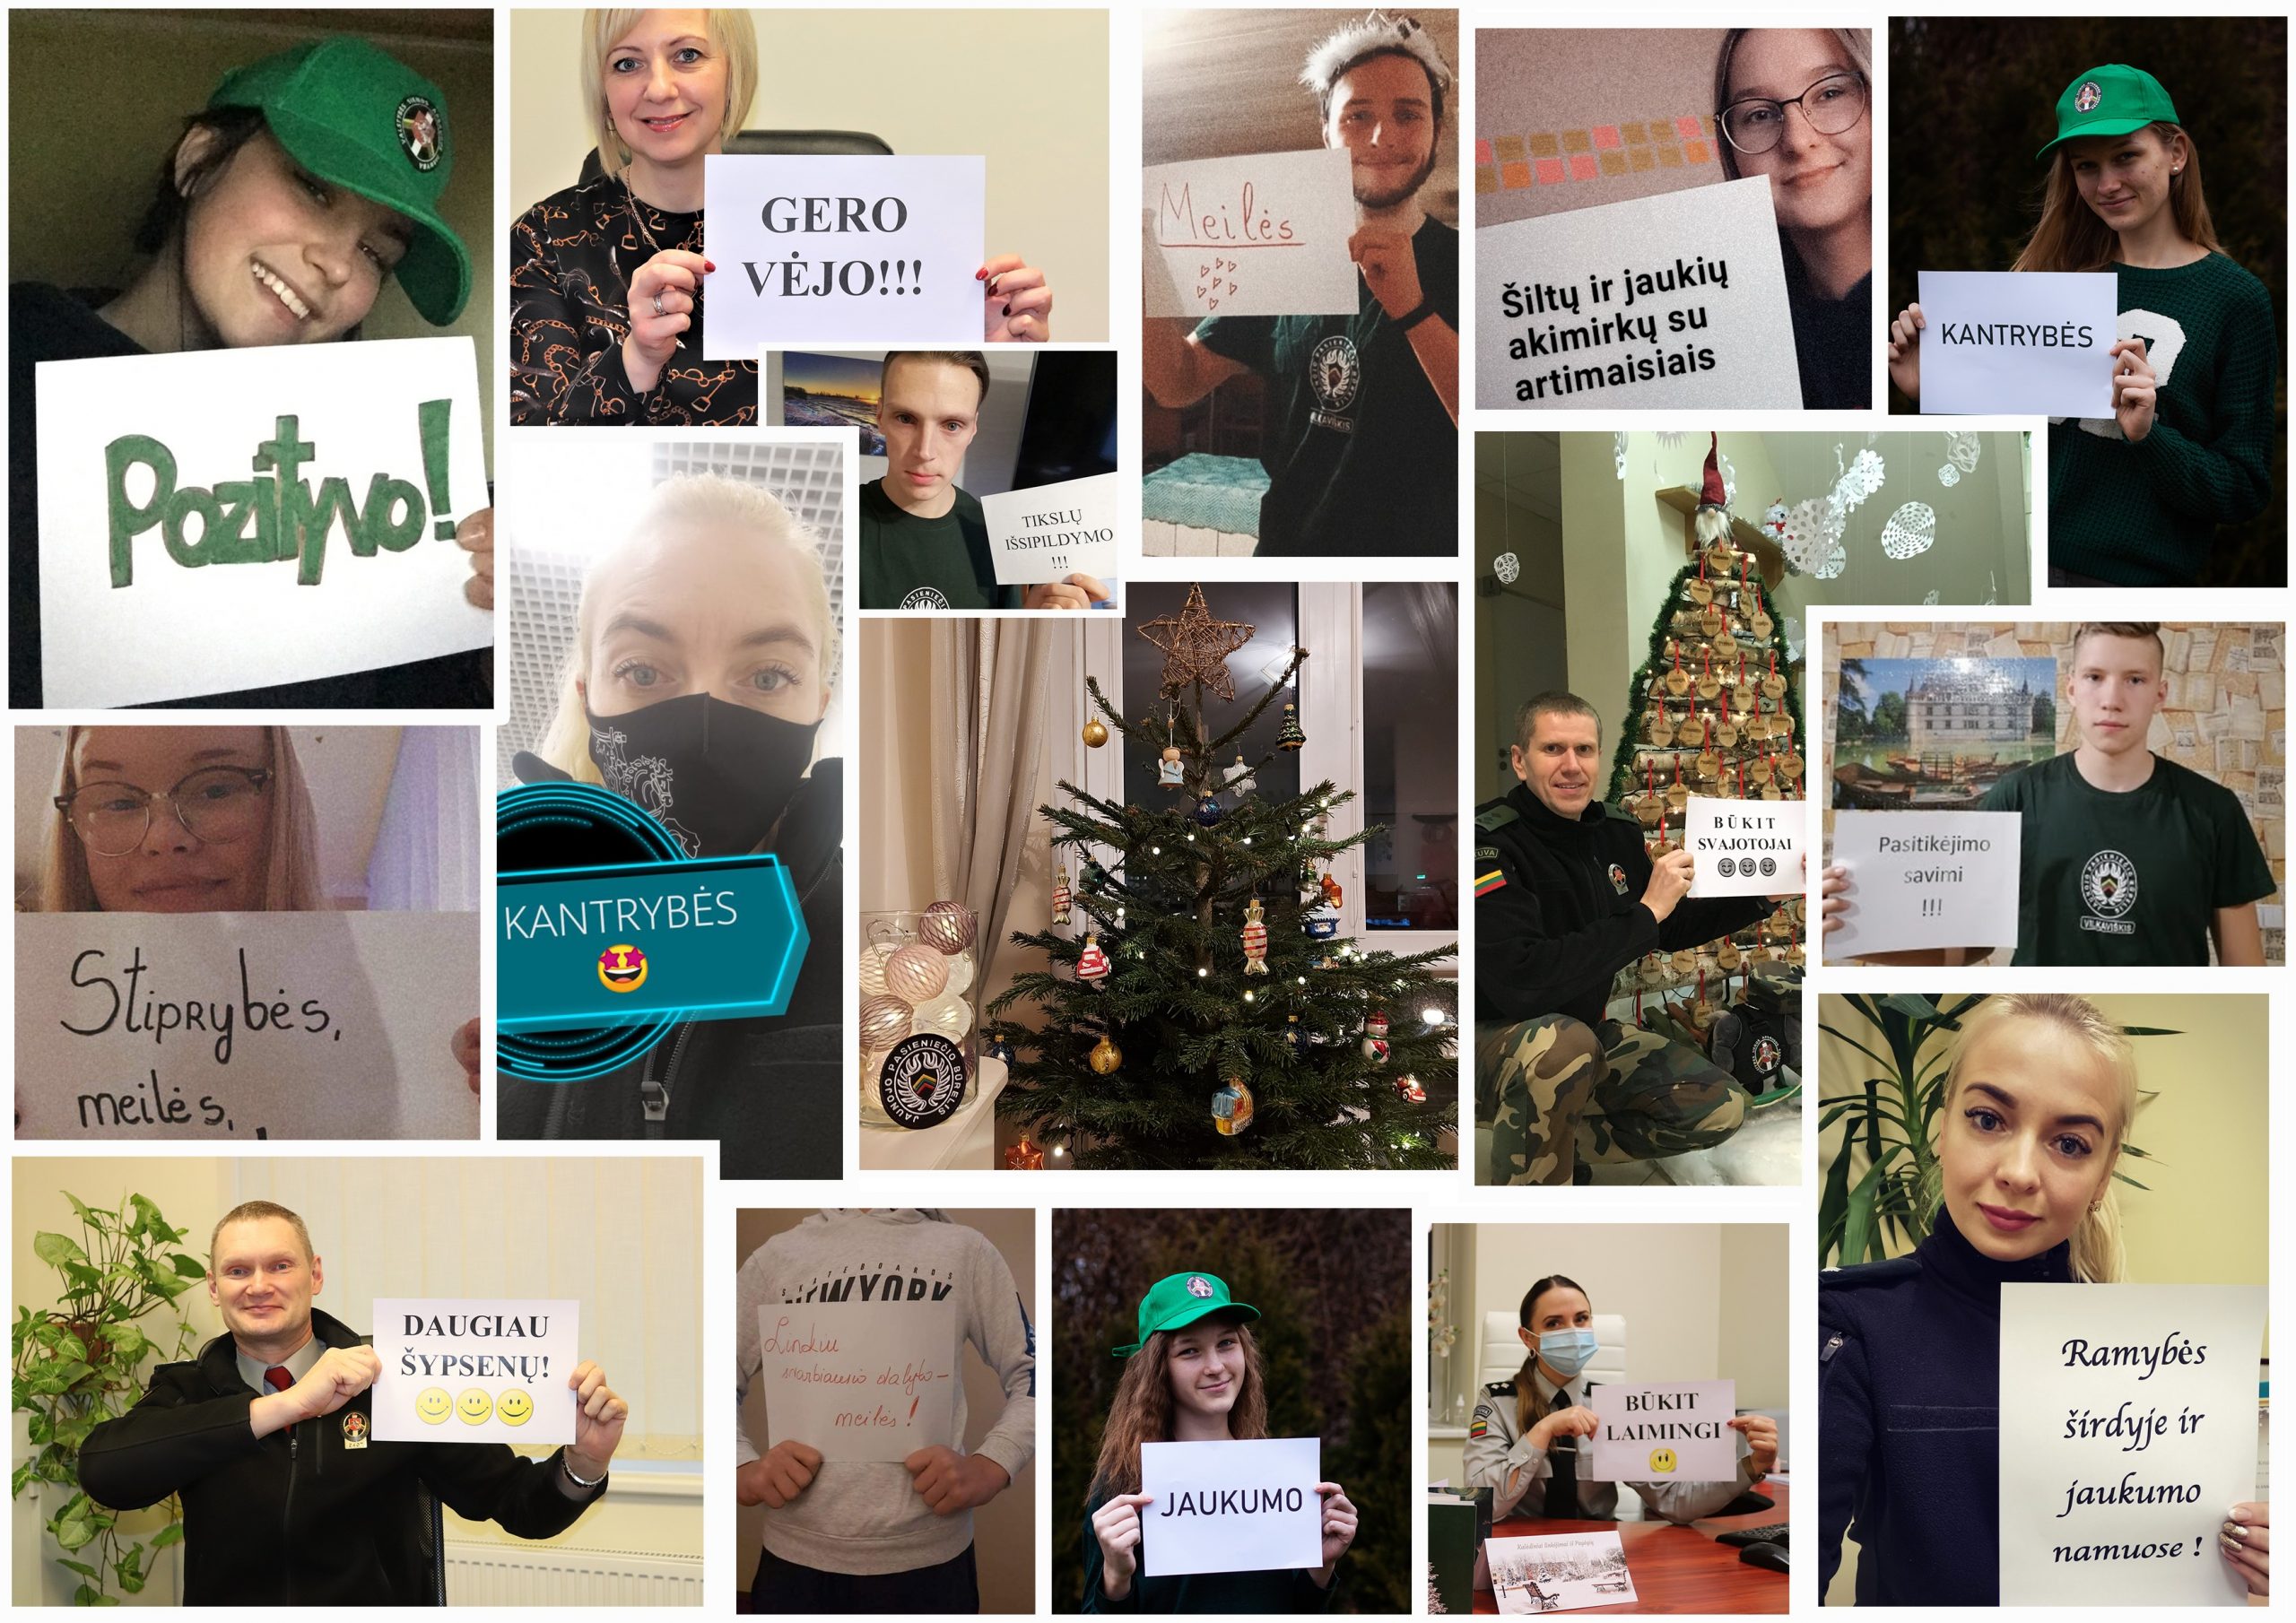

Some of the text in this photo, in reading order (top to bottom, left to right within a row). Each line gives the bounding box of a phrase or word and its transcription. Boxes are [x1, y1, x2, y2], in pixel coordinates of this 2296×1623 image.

[761, 196, 908, 234] GERO
[1161, 182, 1293, 240] Meilės
[741, 250, 922, 298] VĖJO!!!
[1501, 256, 1729, 318] Šiltų ir jaukių
[1509, 307, 1708, 360] akimirkų su
[1942, 321, 2093, 348] KANTRYBĖS
[1515, 343, 1716, 402] artimaisiais
[104, 399, 457, 589] Pozityvo!
[1022, 509, 1083, 528] TIKSLŲ
[1005, 528, 1113, 551] IŠSIPILDYMO
[1051, 556, 1068, 569] !!!
[902, 590, 948, 610] PASIENIEČI
[1698, 838, 1792, 851] SVAJOTOJAI
[1879, 835, 1992, 855] Pasitikėjimo
[1904, 865, 1963, 884] savimi
[1922, 898, 1943, 917] !!!
[888, 1040, 956, 1072] PASIENIEČIO
[77, 1069, 234, 1132] meilės,
[884, 1078, 919, 1123] JAUNOJO
[403, 1315, 550, 1338] DAUGIAU
[401, 1347, 550, 1384] ŠYPSENŲ!
[2061, 1331, 2207, 1381] Ramybės
[1625, 1391, 1700, 1411] BŪKIT
[1606, 1422, 1721, 1441] LAIMINGI
[2063, 1402, 2205, 1452] širdyje ir
[1161, 1487, 1303, 1517] JAUKUMO
[2056, 1471, 2201, 1518] jaukumo
[2052, 1542, 2184, 1564] namuose
